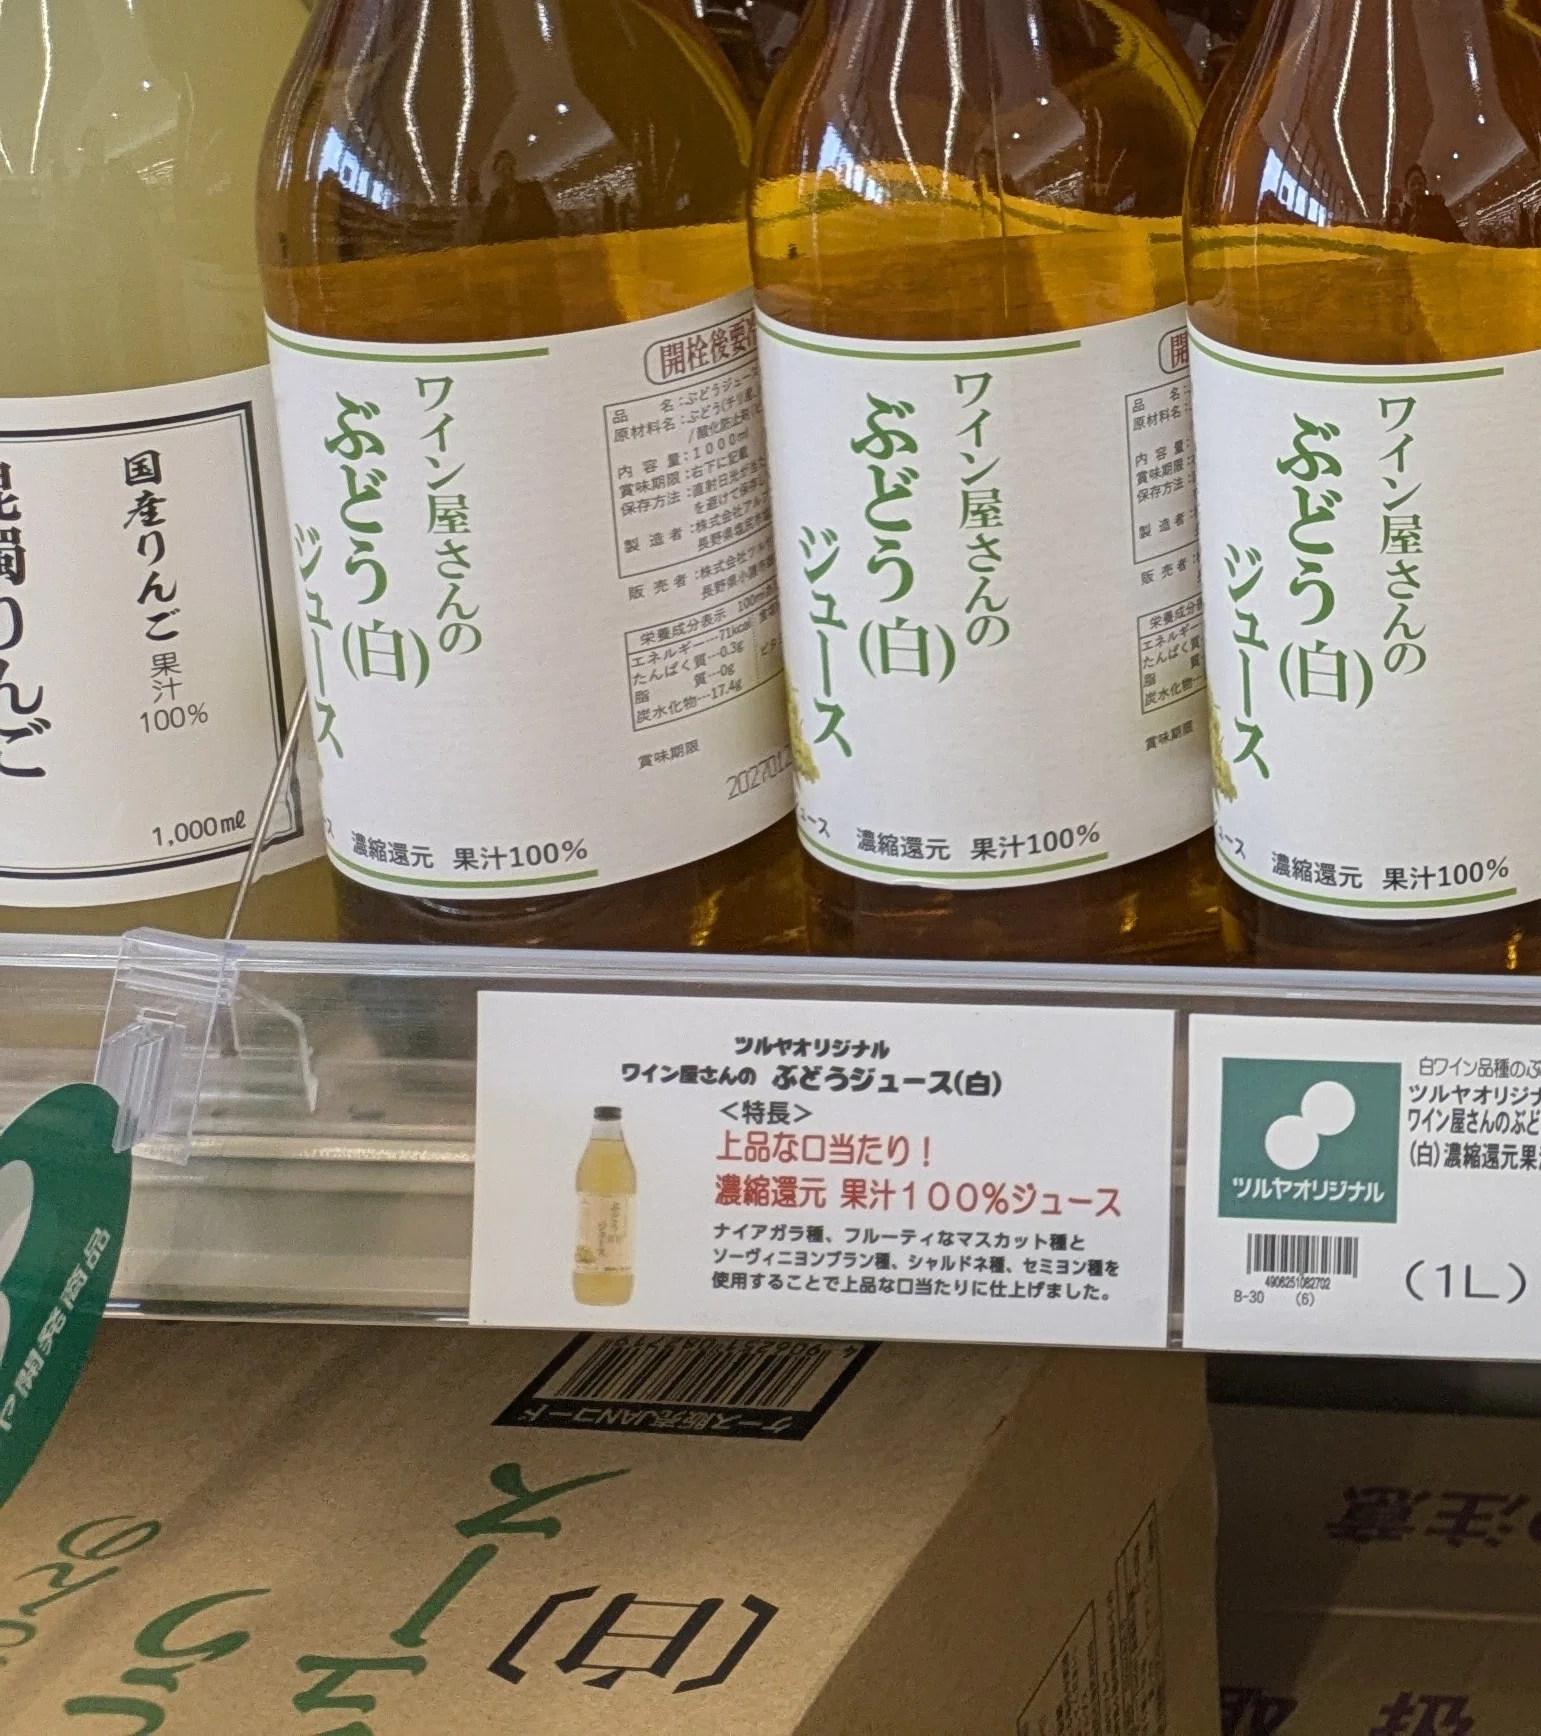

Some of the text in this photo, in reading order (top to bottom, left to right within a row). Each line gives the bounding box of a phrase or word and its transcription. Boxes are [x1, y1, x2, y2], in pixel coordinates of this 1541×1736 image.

[414, 375, 483, 656] ワイン屋さんの
[1378, 395, 1428, 677] ワイン屋さんの
[121, 449, 181, 643] 国産りんご
[292, 522, 345, 760] ジュース
[1223, 543, 1271, 780] ジュース
[151, 652, 182, 703] 果汁
[139, 702, 209, 735] 100%
[349, 832, 589, 873] 濃縮還元 果汁100%
[1271, 850, 1509, 892] 濃縮還元 果汁100%
[734, 1035, 891, 1061] ツルヤオリジナル
[621, 1062, 757, 1088] ワイン屋さんの
[714, 1173, 827, 1211] 濃縮還元
[1232, 1176, 1386, 1204] ツルヤオリジナル
